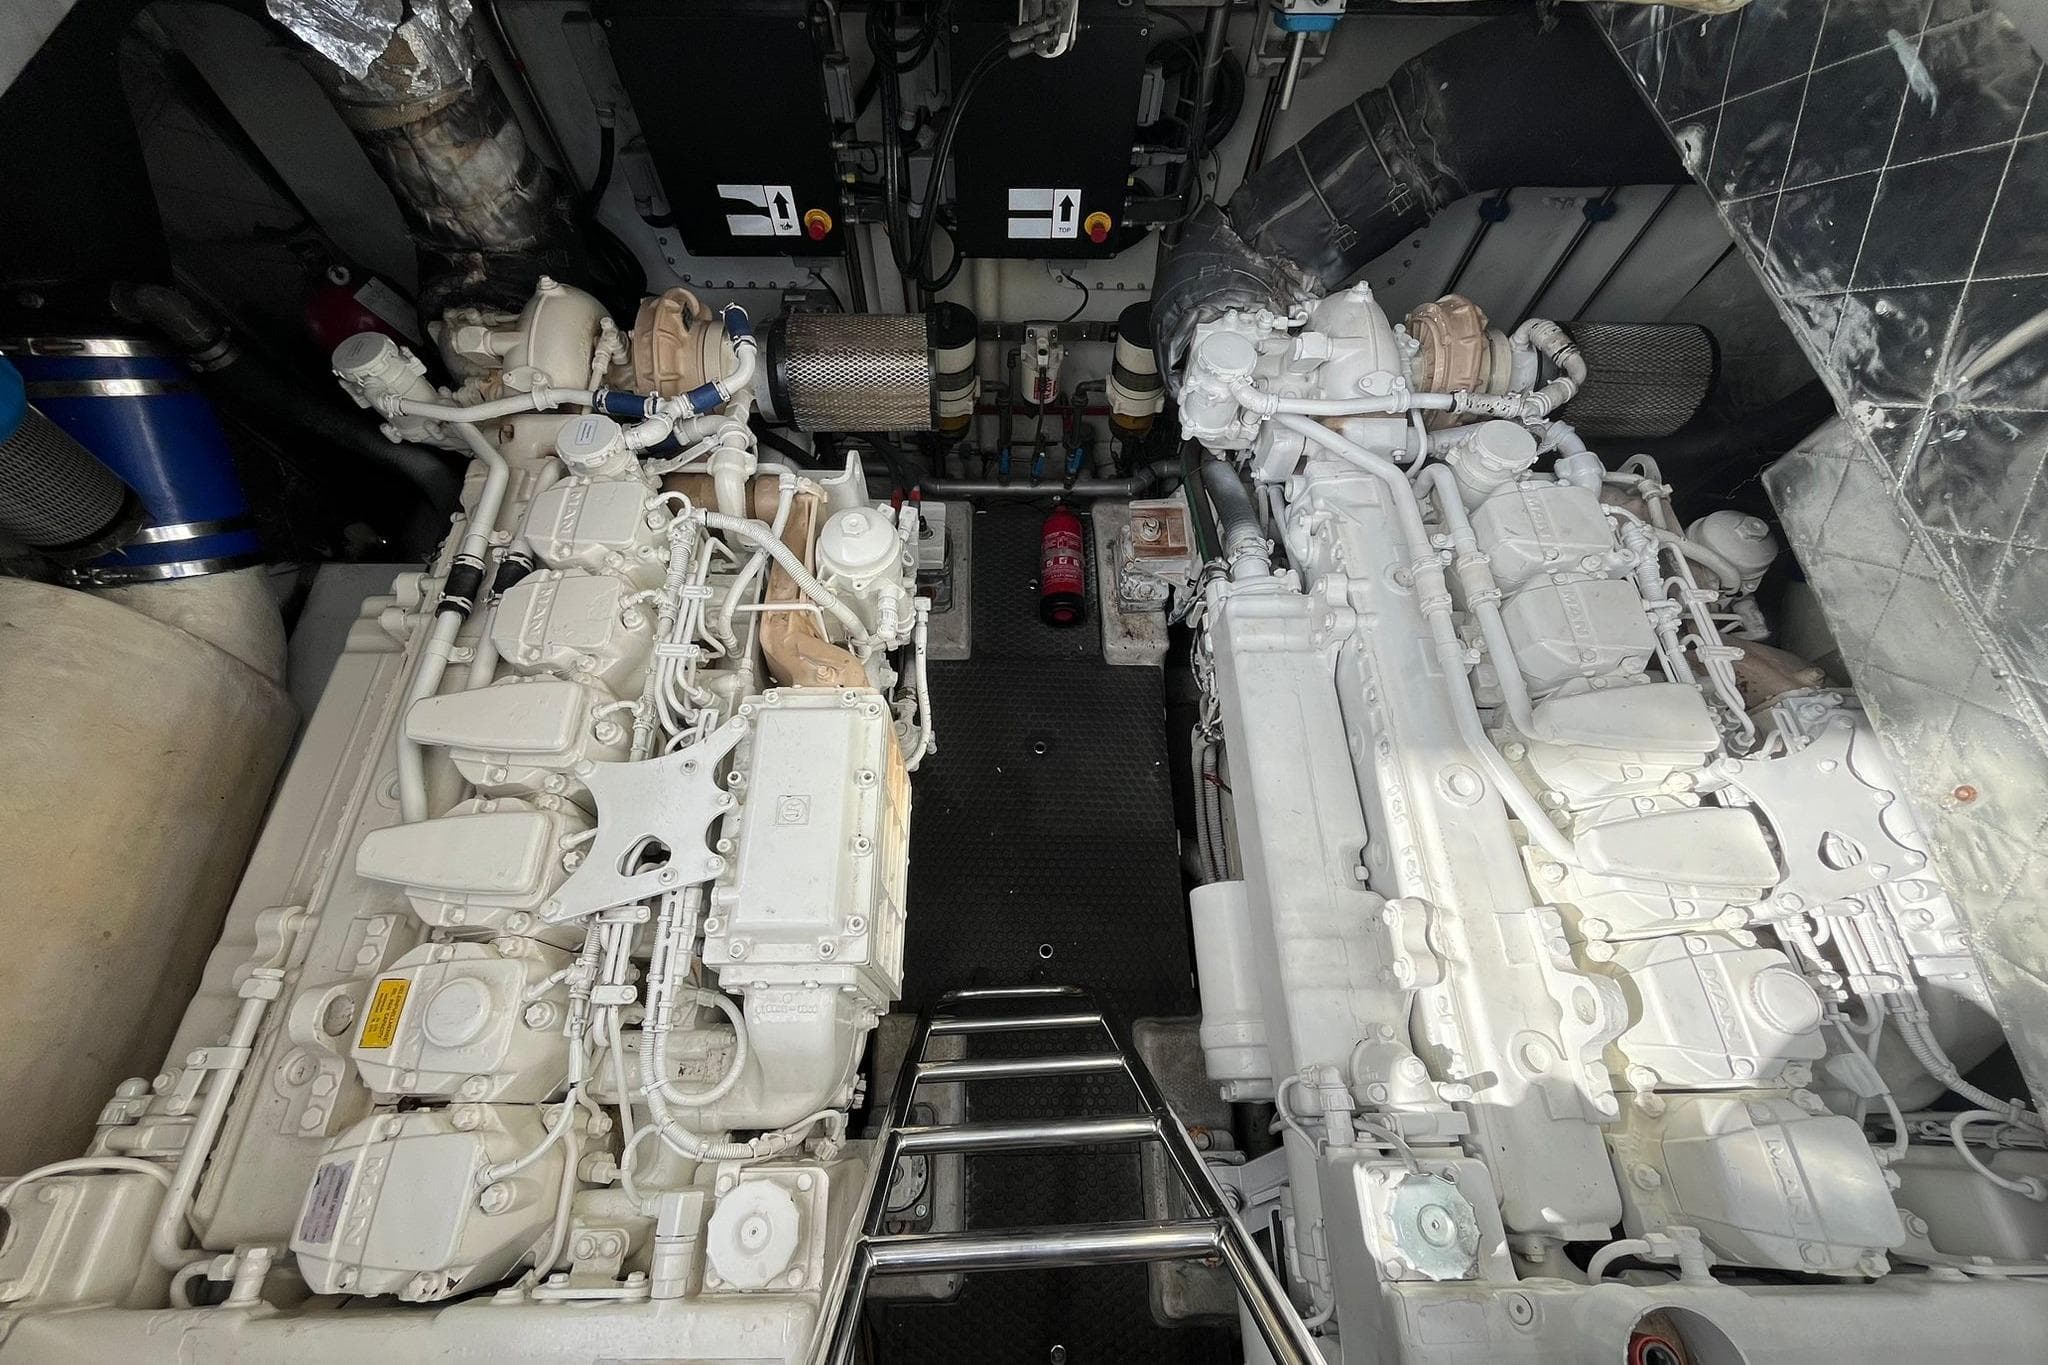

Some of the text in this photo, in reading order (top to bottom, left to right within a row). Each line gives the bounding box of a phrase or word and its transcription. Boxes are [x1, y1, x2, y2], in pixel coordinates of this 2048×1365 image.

[1700, 967, 1742, 1041] MAN
[343, 1156, 385, 1246] MAN
[1765, 1139, 1810, 1226] MAN
